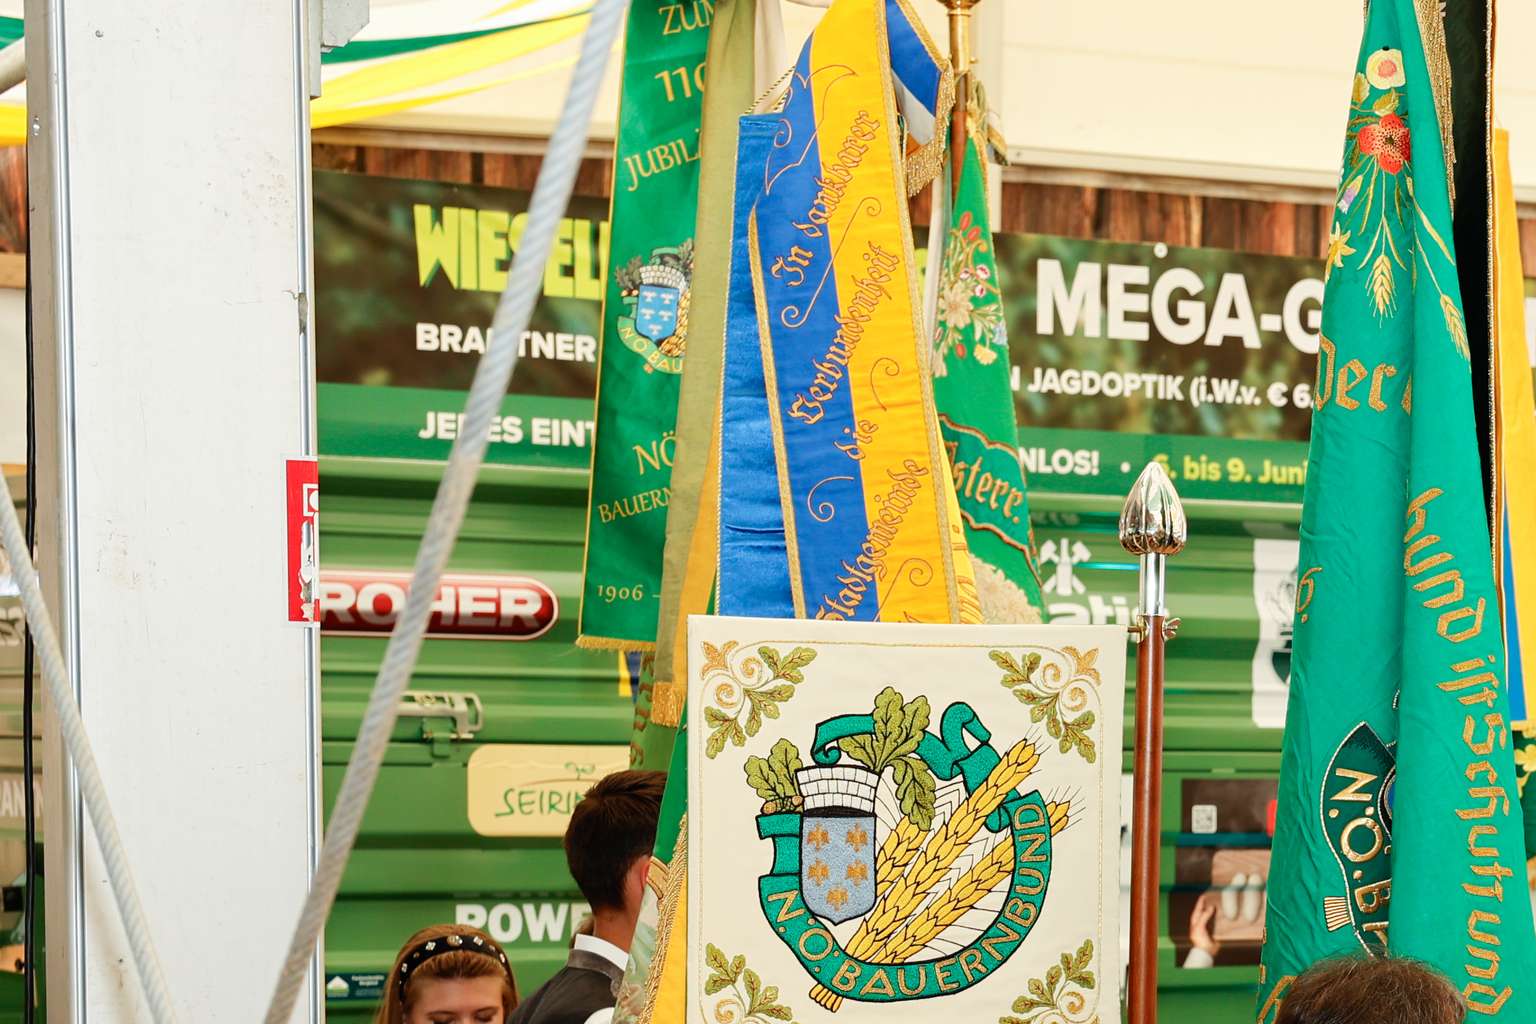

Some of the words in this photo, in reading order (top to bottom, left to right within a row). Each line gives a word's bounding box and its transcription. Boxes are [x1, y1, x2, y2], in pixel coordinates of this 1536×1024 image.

[623, 128, 702, 191] JUBIL
[791, 110, 882, 239] dankbarer
[413, 204, 610, 301] WIEEL
[787, 241, 900, 424] Verbundenheit
[1027, 366, 1185, 401] JAGDOPTIK
[1266, 381, 1289, 409] €
[418, 411, 524, 445] JEES
[833, 418, 880, 461] die
[1183, 455, 1222, 482] bis
[1226, 457, 1252, 484] 9.
[1464, 911, 1514, 1015] und
